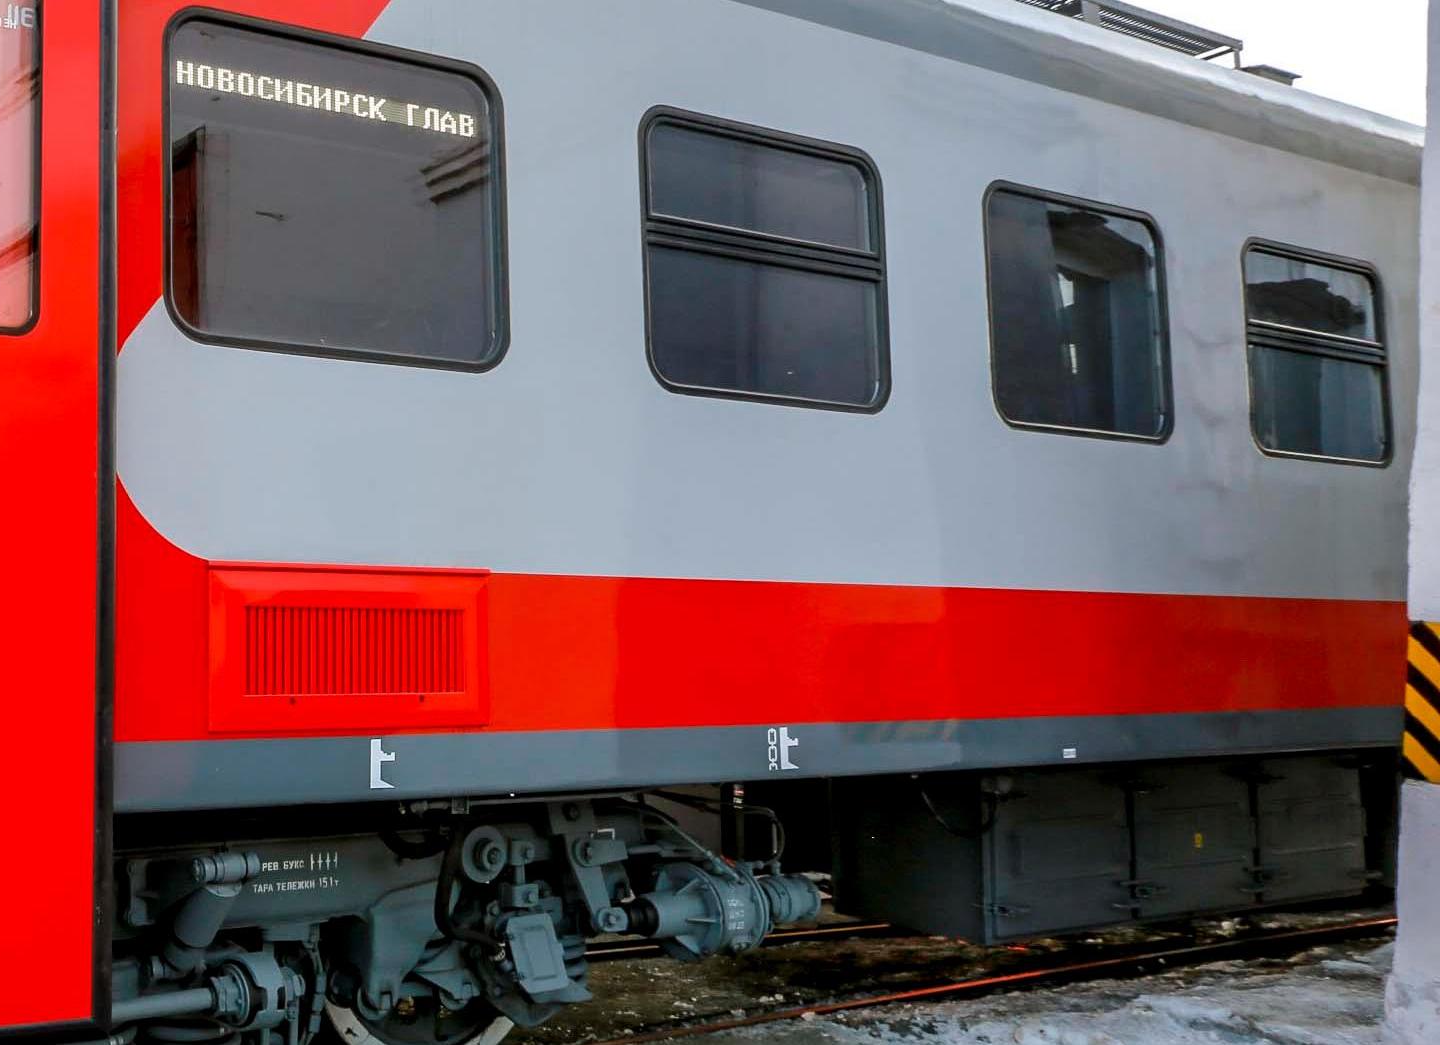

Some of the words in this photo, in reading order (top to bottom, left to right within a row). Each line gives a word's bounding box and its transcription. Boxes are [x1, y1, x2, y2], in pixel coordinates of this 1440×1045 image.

[176, 60, 387, 121] НОВОСИБИРСК
[406, 104, 475, 138] ГЛАВ
[276, 880, 315, 891] ТЕЛЕЖКИ
